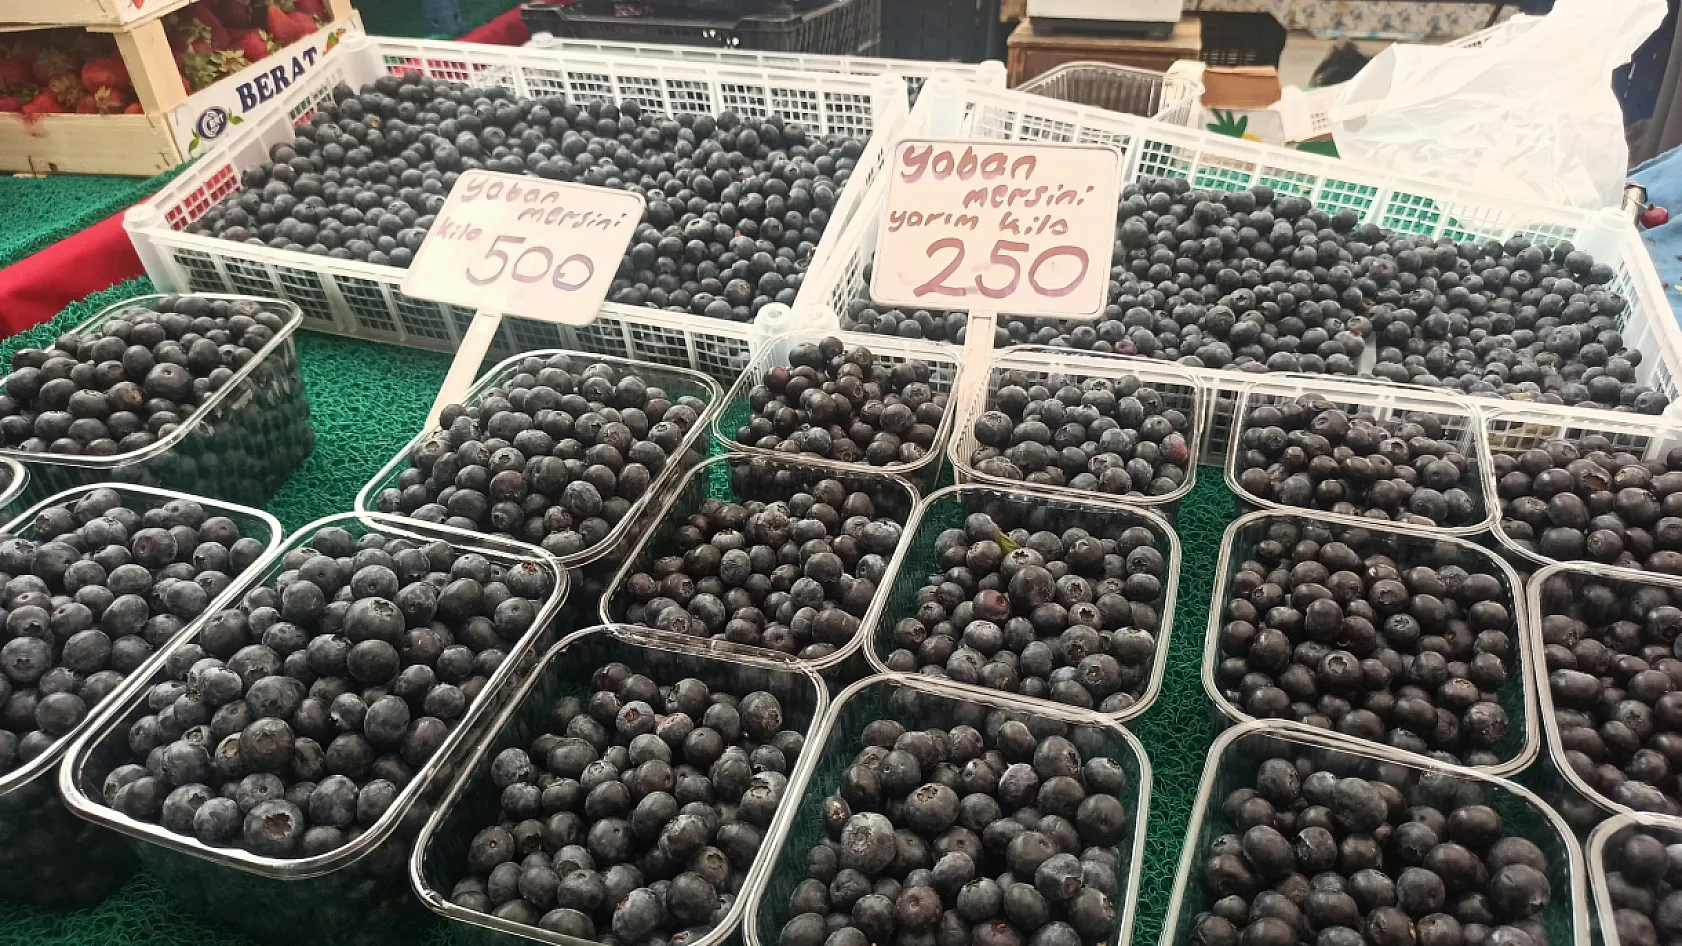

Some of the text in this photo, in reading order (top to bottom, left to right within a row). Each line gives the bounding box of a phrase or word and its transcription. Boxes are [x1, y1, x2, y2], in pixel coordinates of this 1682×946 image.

[235, 46, 318, 114] BERAT
[962, 184, 1095, 209] mersini
[436, 216, 483, 241] kilo
[517, 206, 627, 231] mersini
[999, 211, 1069, 235] kilo
[465, 235, 595, 291] 500
[913, 237, 1090, 299] 250
